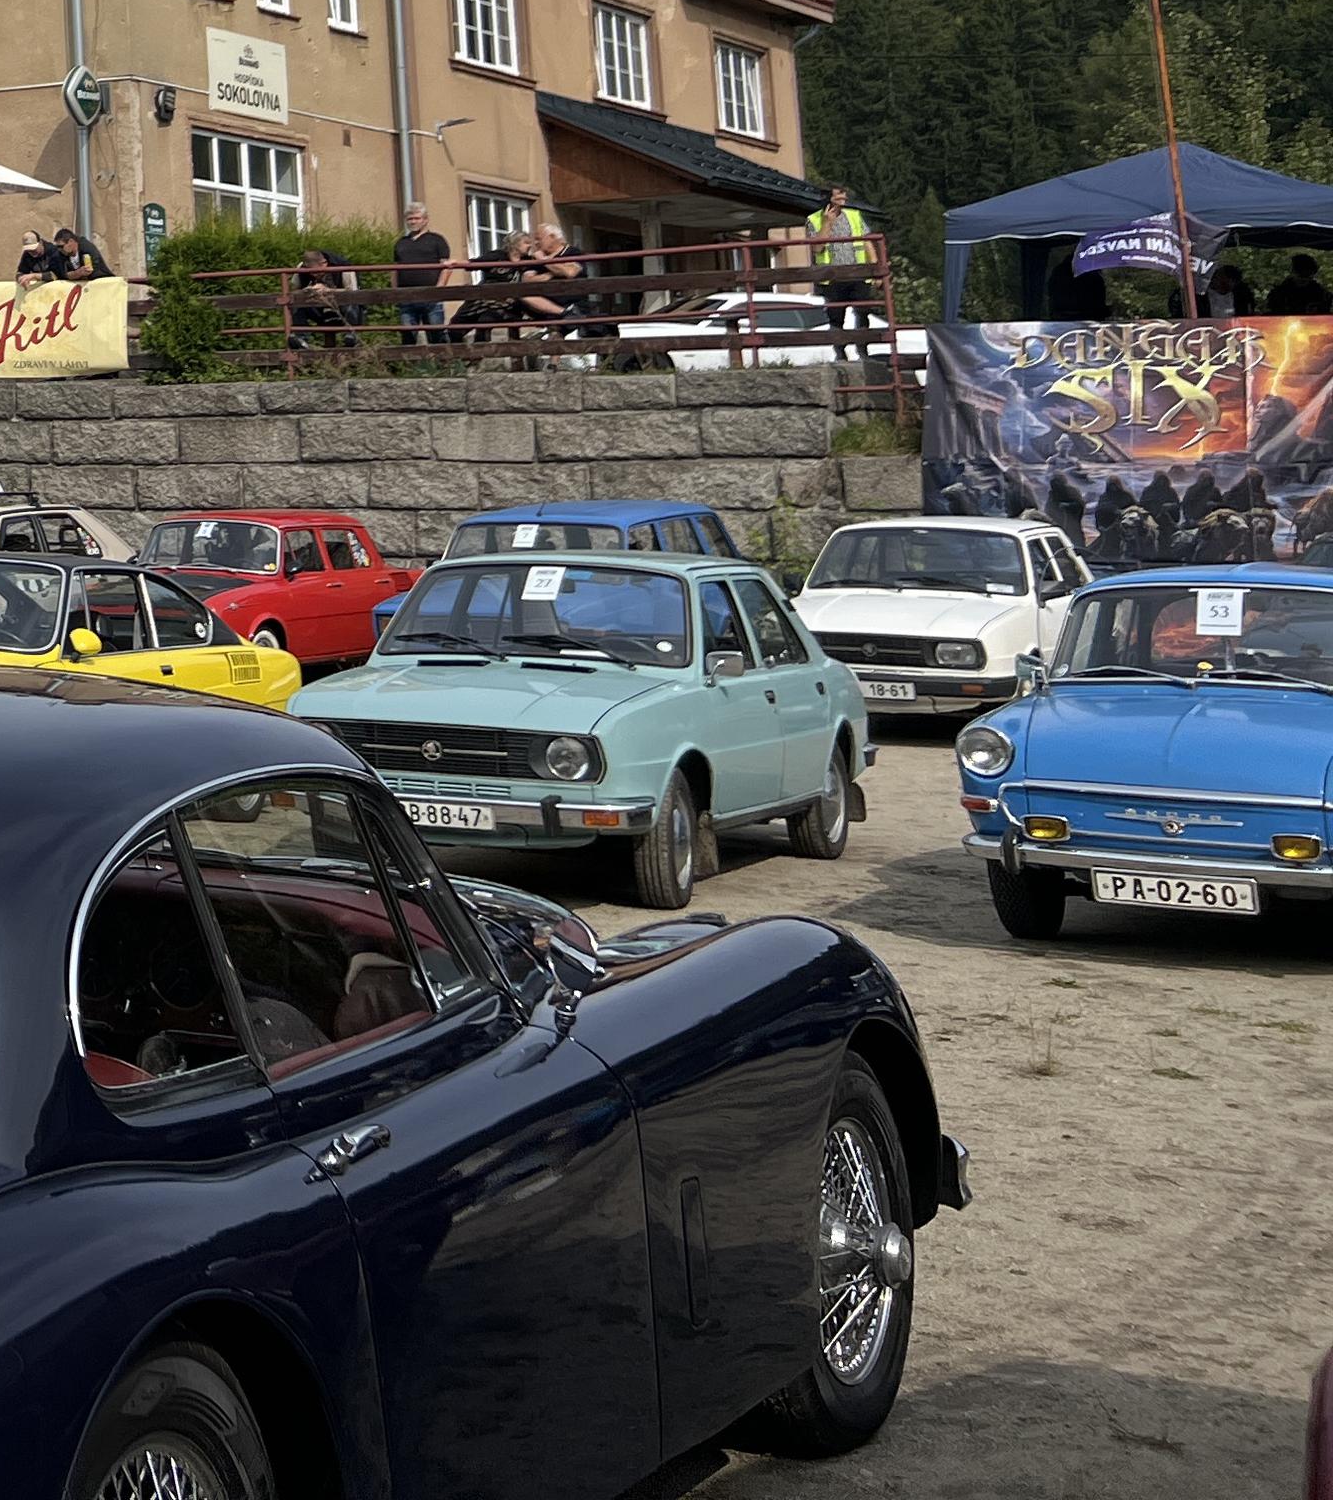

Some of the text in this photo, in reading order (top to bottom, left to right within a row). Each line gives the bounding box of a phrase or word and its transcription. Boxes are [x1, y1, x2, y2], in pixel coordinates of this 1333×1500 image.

[217, 82, 281, 112] SOKOLOVNA
[1042, 359, 1229, 454] SIX
[1209, 605, 1230, 618] 53
[1111, 876, 1238, 908] PA-02-60
